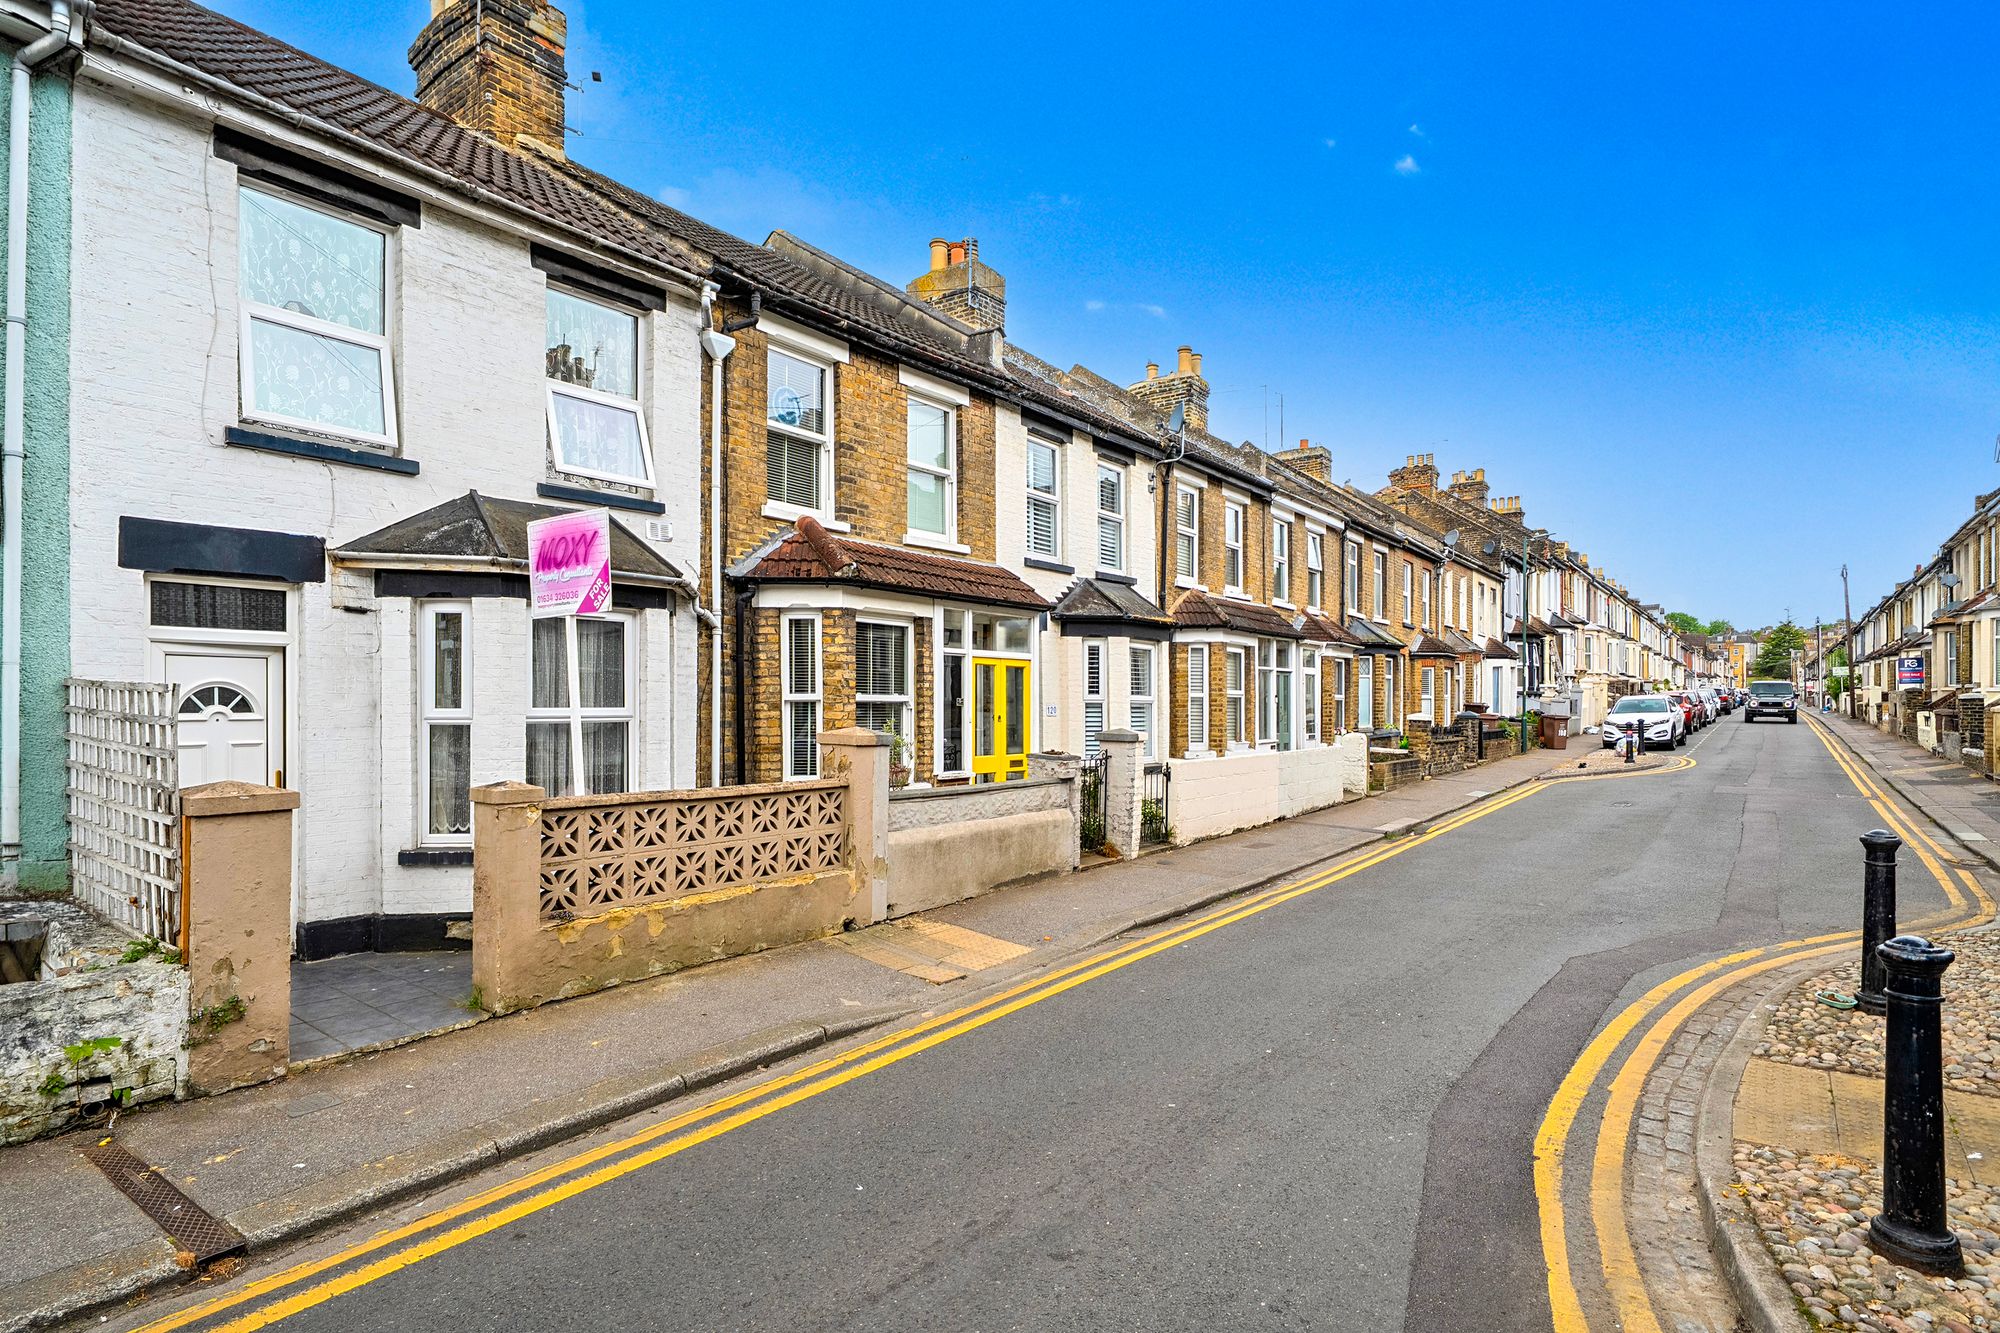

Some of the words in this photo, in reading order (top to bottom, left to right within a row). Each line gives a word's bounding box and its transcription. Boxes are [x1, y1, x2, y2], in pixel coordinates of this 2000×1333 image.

[536, 531, 599, 573] MOXY
[537, 593, 553, 603] 01634
[555, 590, 579, 601] 326036
[589, 578, 604, 600] FOR
[594, 582, 610, 609] SALE
[1047, 706, 1056, 714] 120
